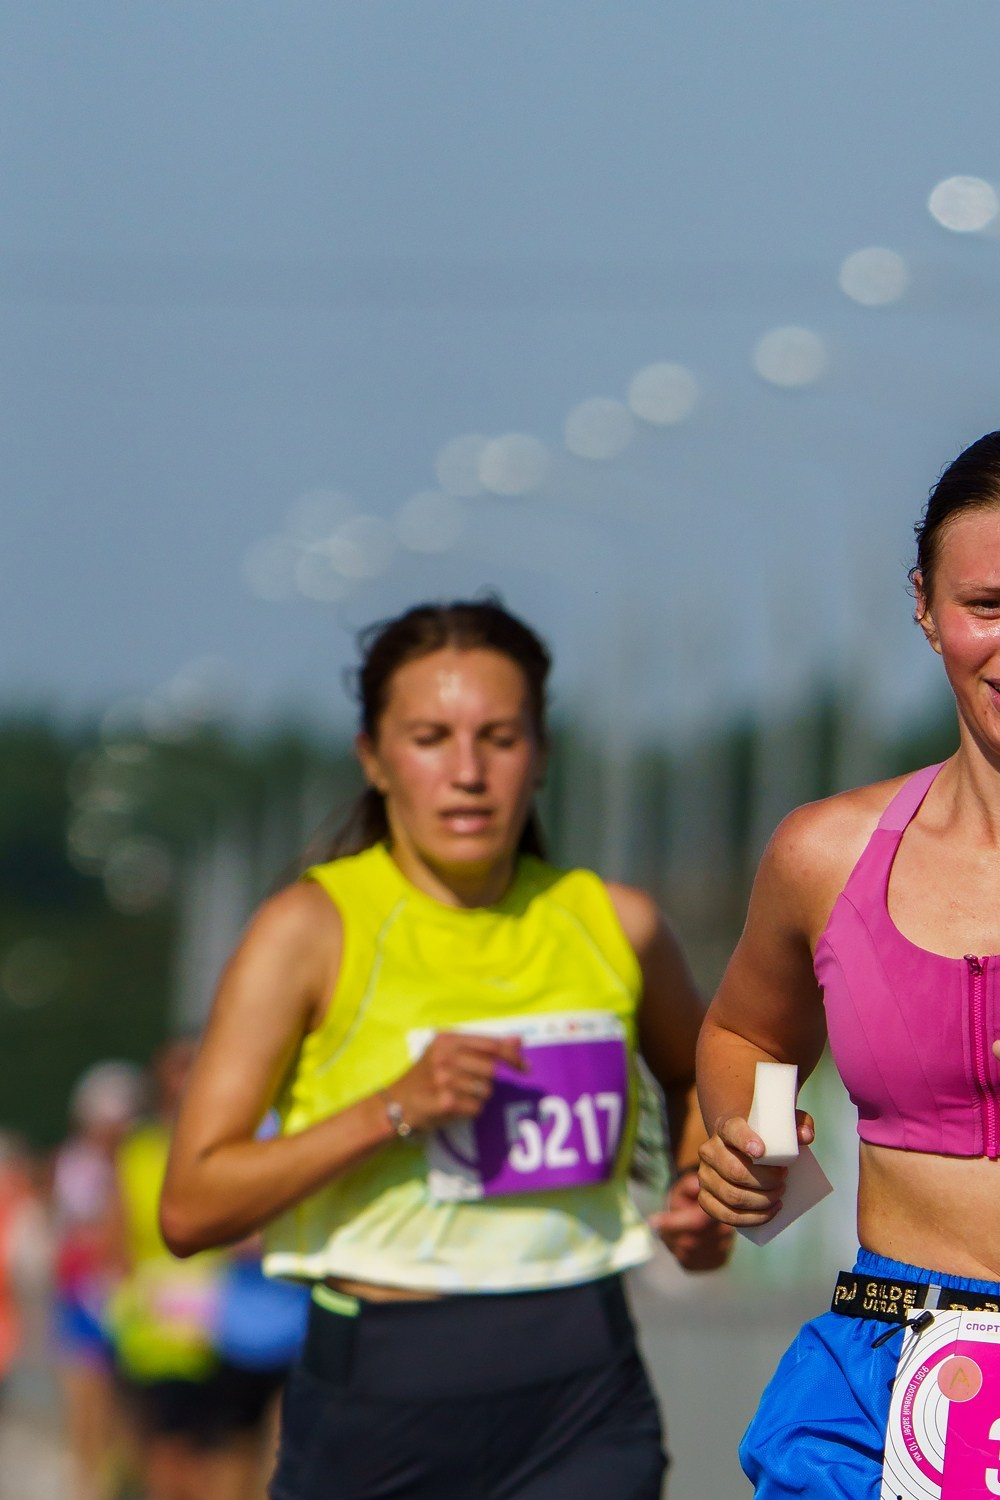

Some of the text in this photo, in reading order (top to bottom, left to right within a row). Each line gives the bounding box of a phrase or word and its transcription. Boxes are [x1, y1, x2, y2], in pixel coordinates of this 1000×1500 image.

[504, 1091, 622, 1173] 5217
[965, 1322, 1000, 1333] СПОРТ
[902, 1383, 917, 1415] розовый
[902, 1416, 912, 1436] забег
[908, 1440, 918, 1451] 10
